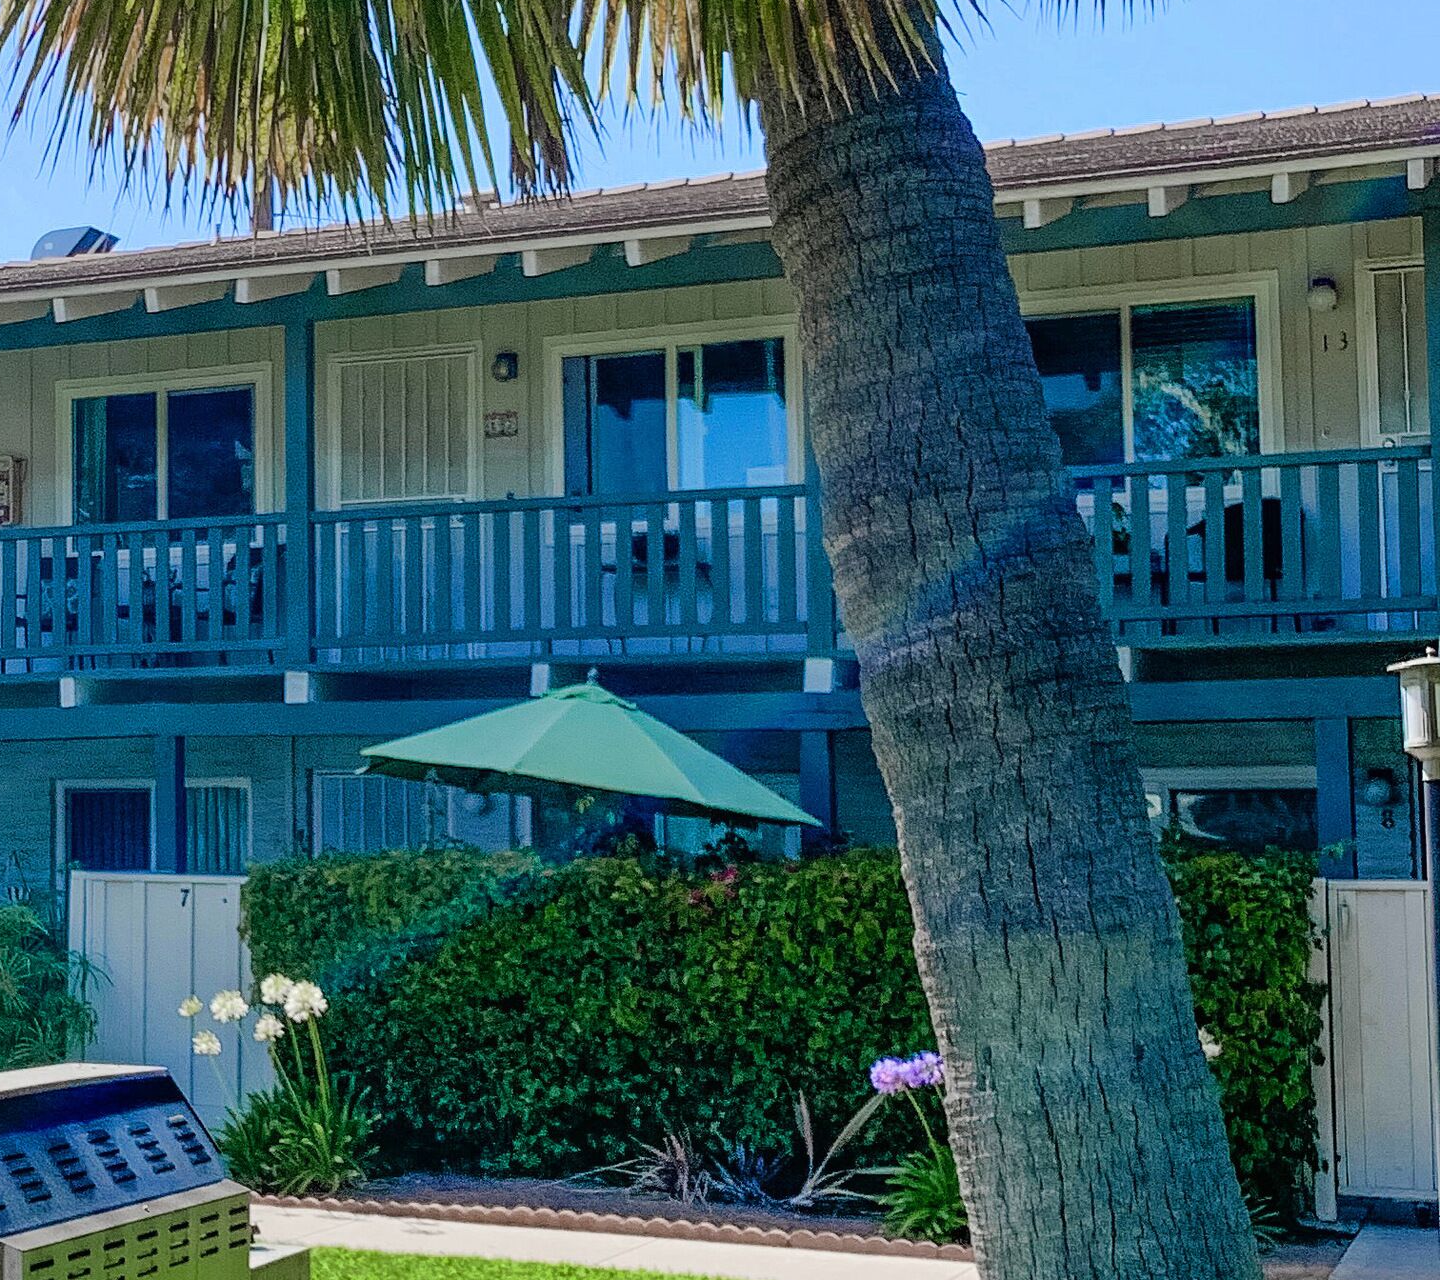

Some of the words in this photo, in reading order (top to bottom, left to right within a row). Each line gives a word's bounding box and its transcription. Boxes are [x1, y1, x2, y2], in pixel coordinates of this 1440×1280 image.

[1323, 330, 1348, 352] 13
[1381, 809, 1395, 829] 8
[180, 888, 190, 908] 7
